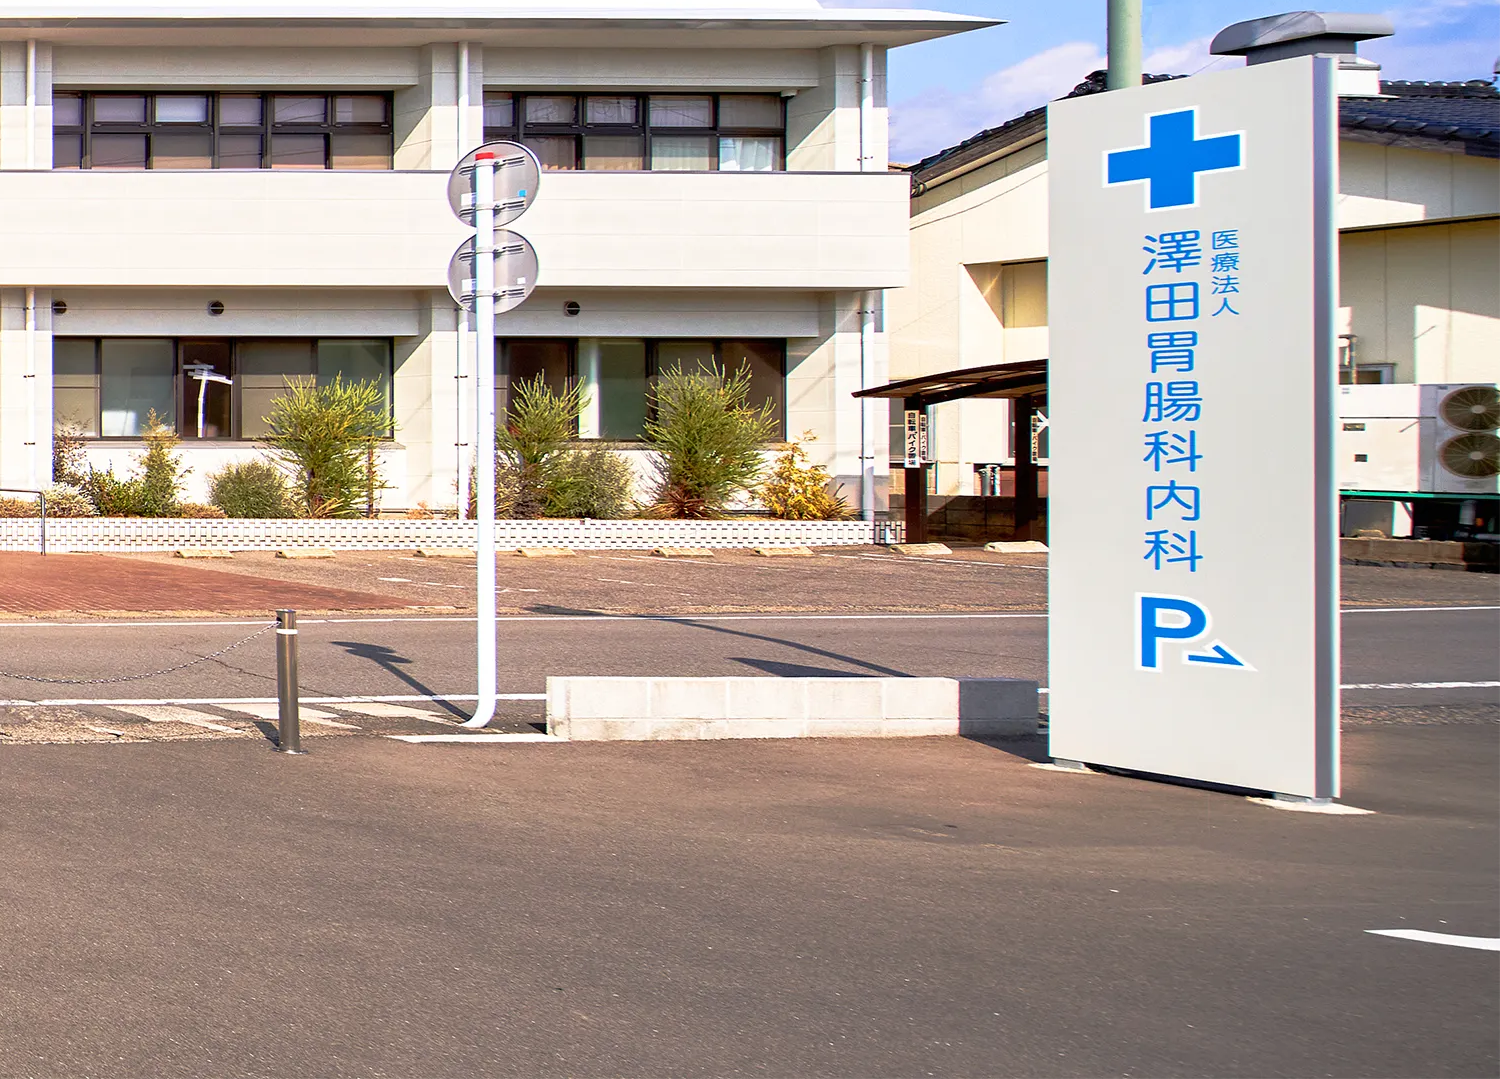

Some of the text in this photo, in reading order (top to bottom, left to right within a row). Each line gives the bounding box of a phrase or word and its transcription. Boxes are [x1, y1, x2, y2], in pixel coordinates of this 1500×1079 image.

[1210, 228, 1240, 318] 医療法人
[1142, 230, 1203, 573] 澤田胃腸科内科
[1141, 596, 1205, 669] P
